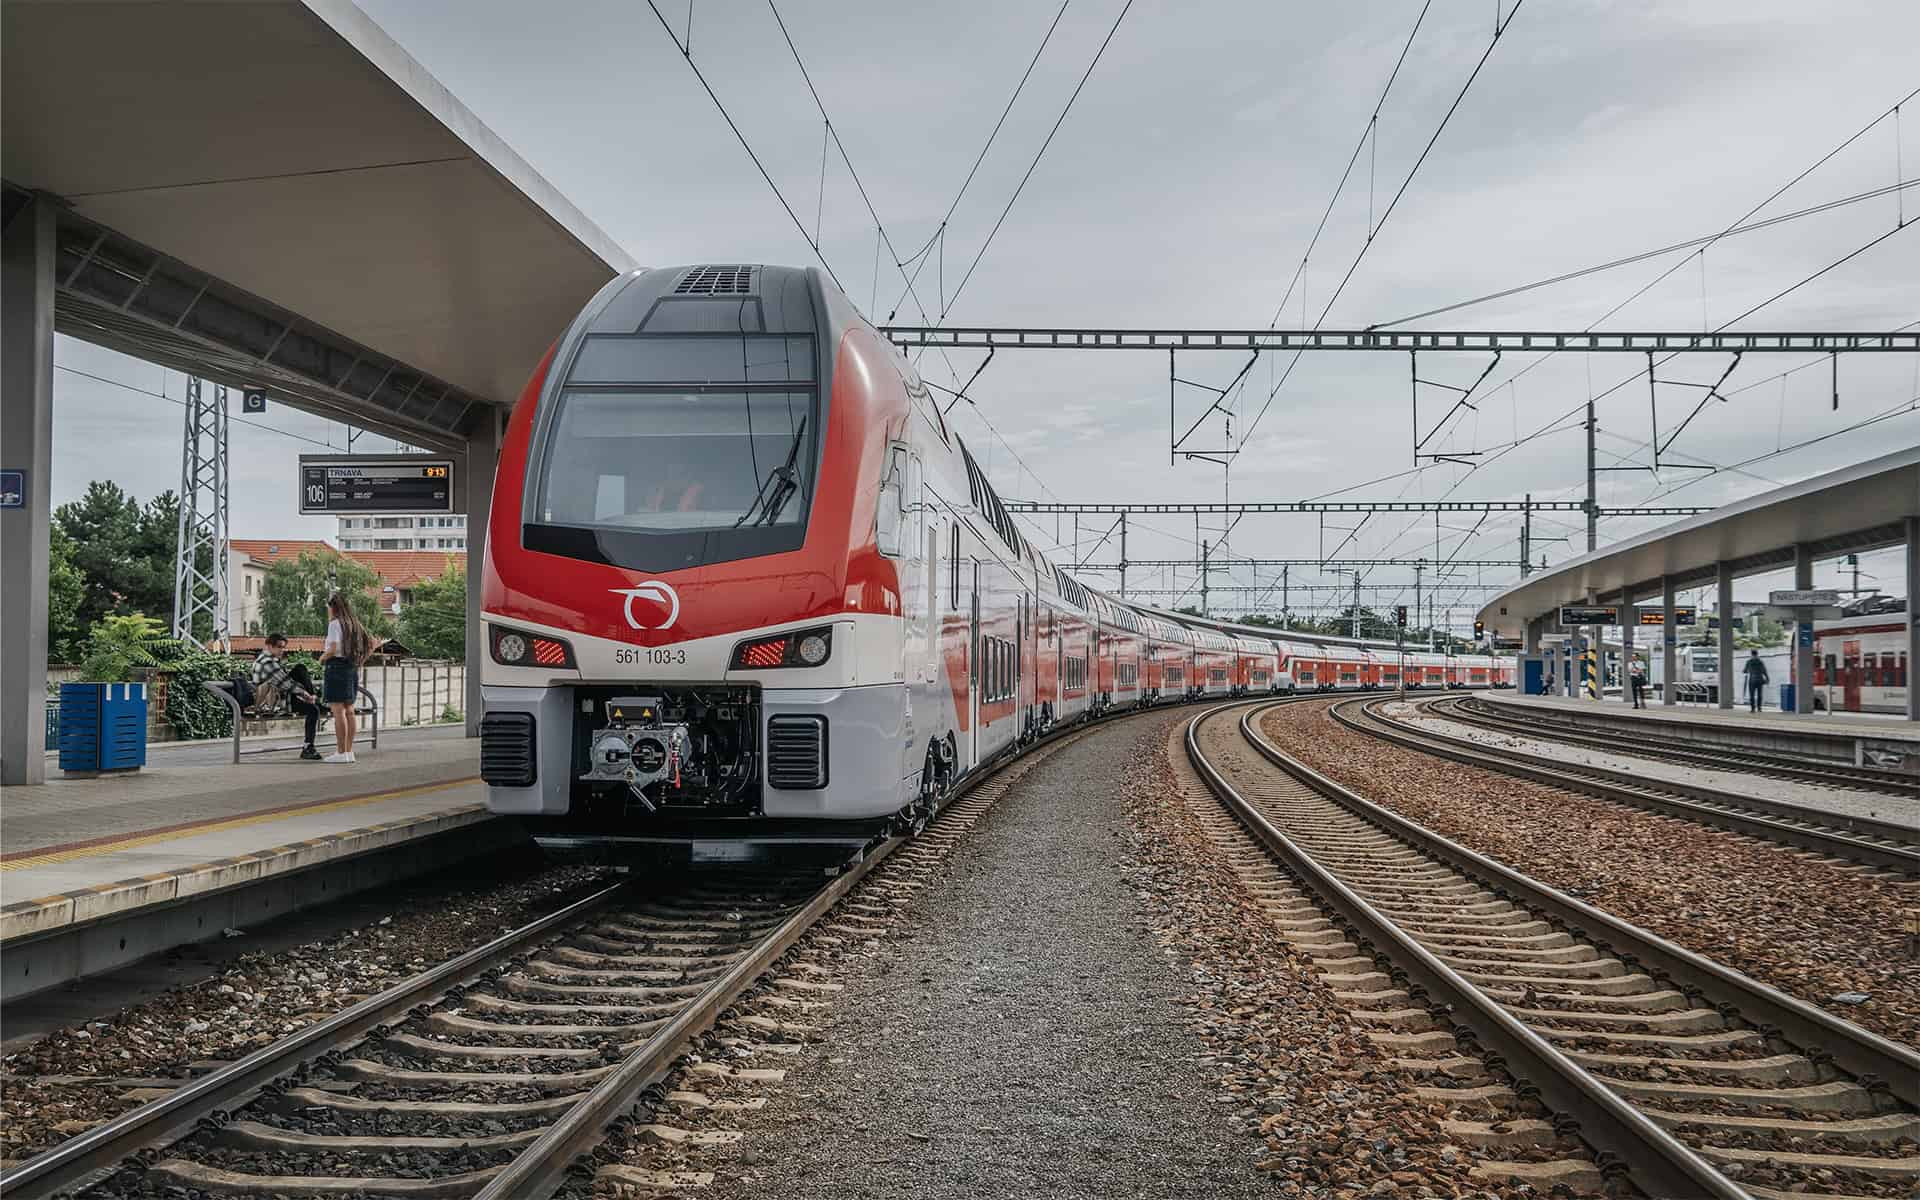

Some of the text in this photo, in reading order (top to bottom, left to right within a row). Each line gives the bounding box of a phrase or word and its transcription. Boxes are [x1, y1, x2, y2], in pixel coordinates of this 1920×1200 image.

[248, 394, 261, 408] G
[306, 485, 324, 502] 106
[616, 650, 686, 664] 561 103-3
